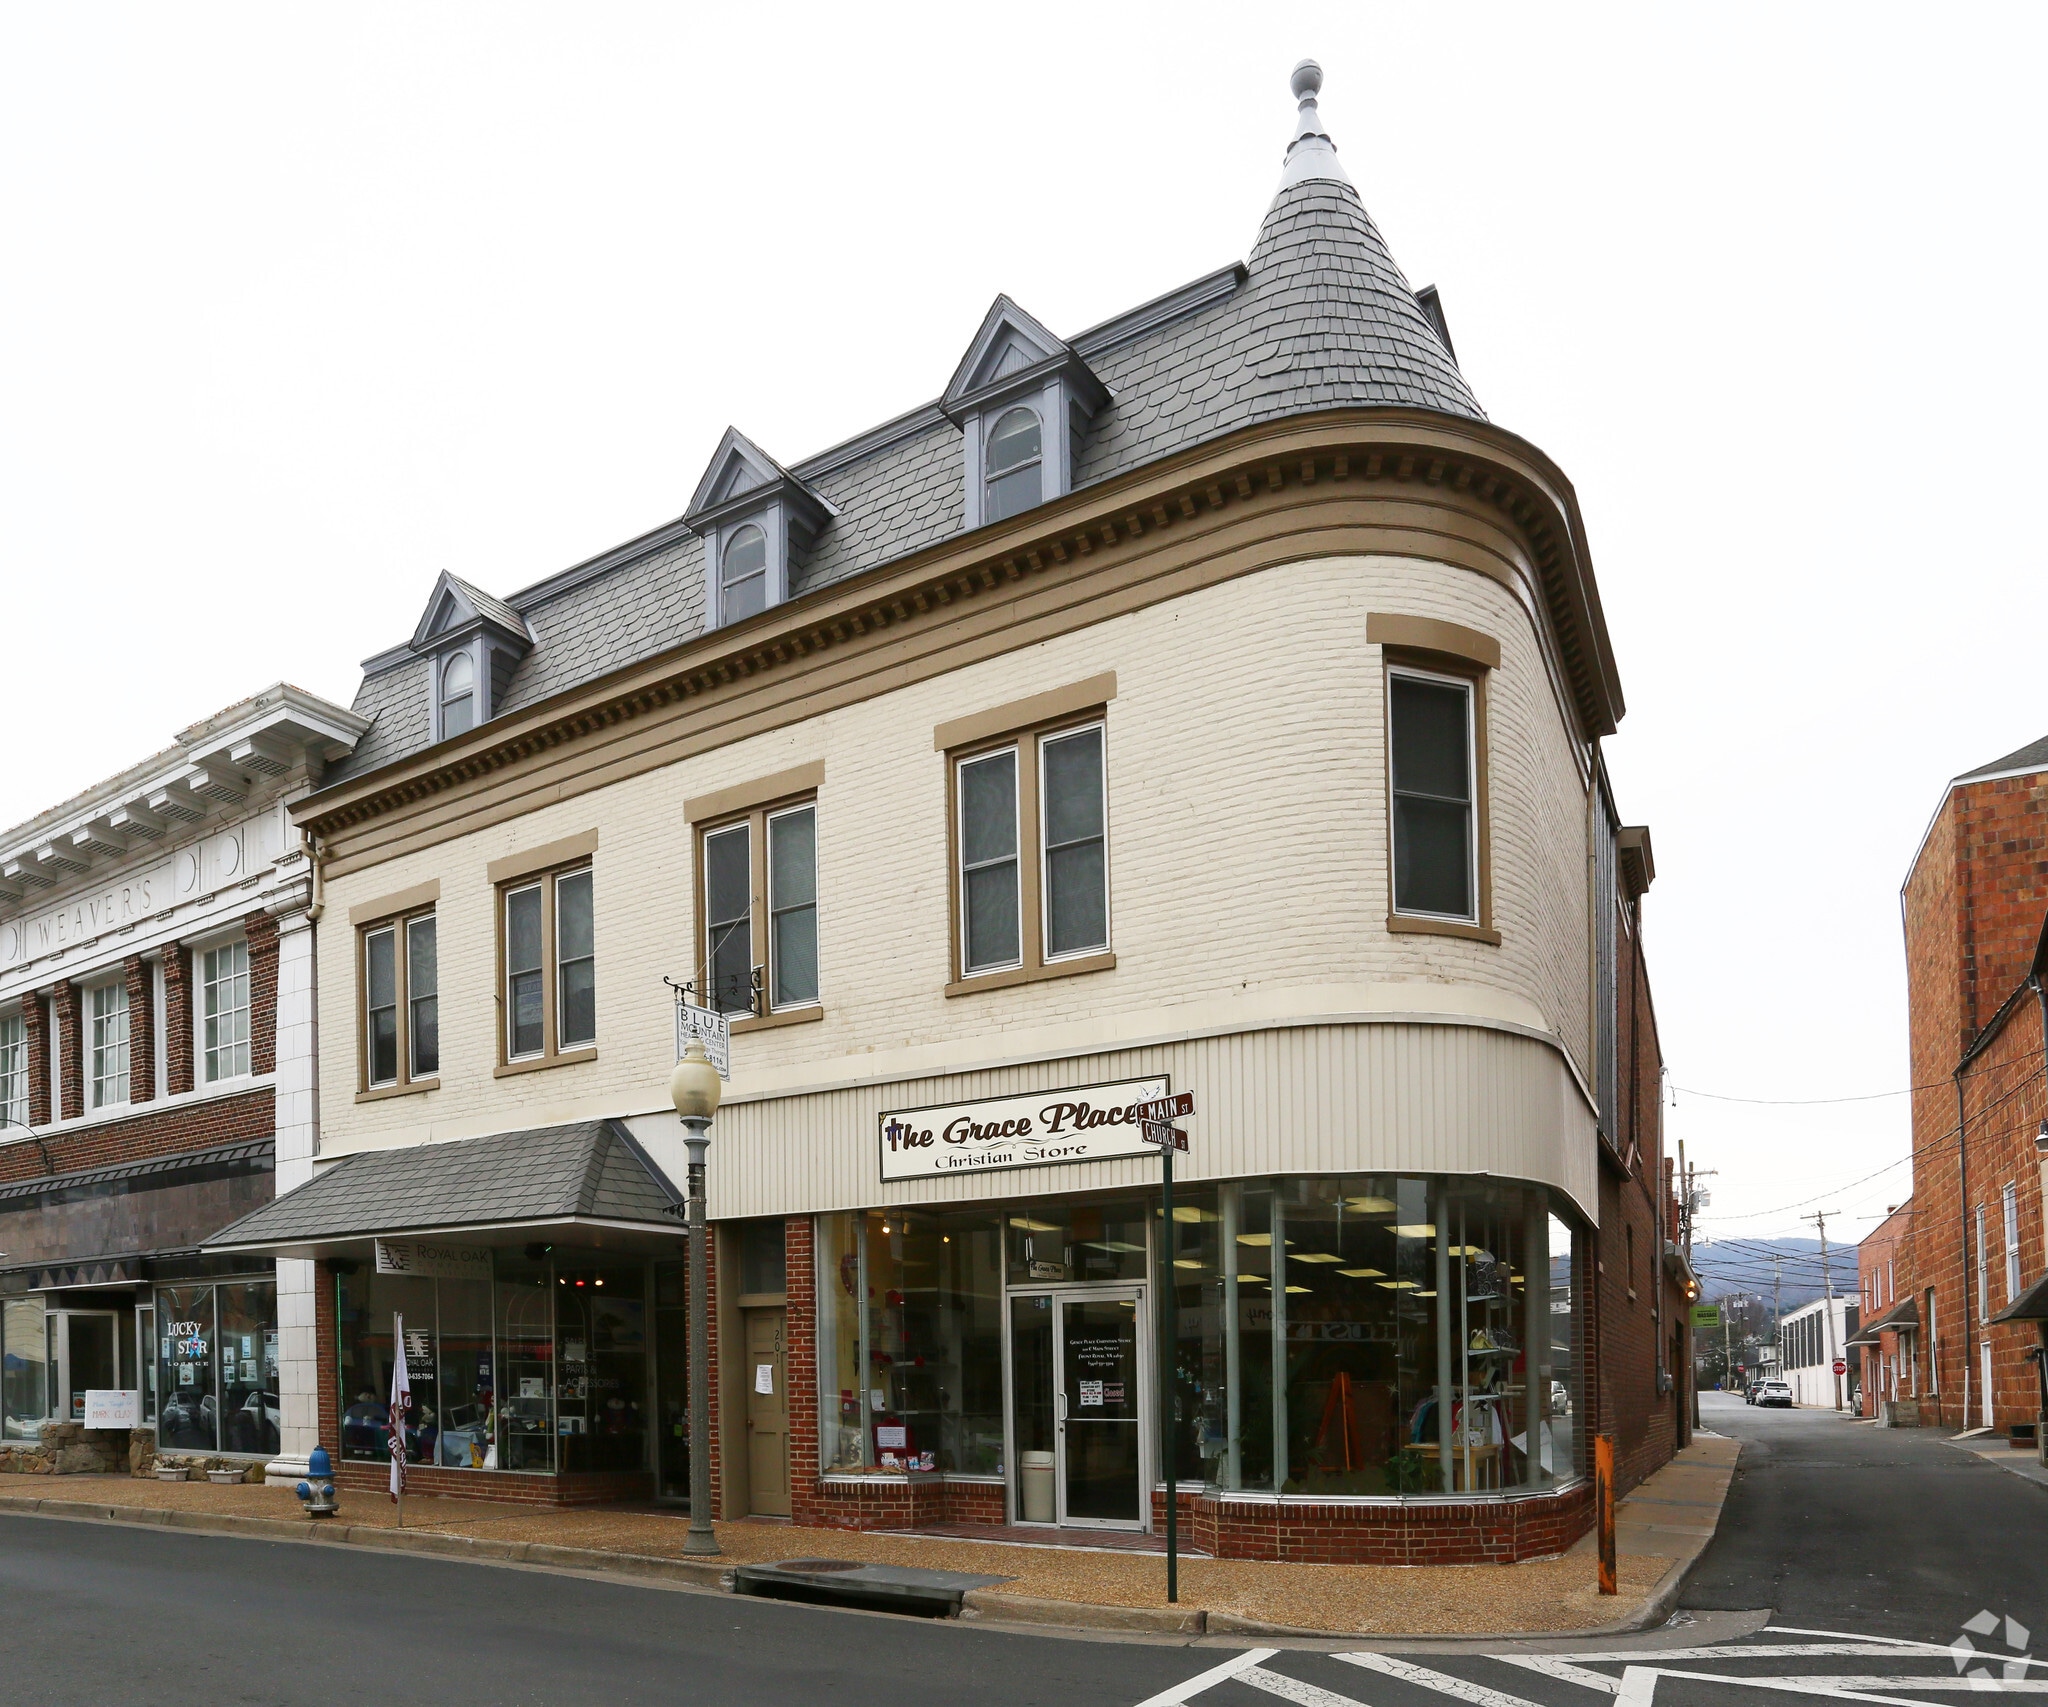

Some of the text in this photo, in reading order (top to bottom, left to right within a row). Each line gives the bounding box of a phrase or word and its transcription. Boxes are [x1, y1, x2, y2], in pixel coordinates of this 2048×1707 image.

[37, 879, 151, 949] WEAVER'S
[680, 1008, 725, 1033] BLUE
[681, 1022, 726, 1042] MOUNTAIN
[705, 1037, 726, 1049] CENTER
[1140, 1098, 1189, 1120] E MAIN ST
[942, 1116, 1033, 1145] Grace
[1039, 1102, 1137, 1134] Place
[1145, 1123, 1177, 1147] CHURCH
[935, 1145, 1088, 1169] Christian Store
[417, 1244, 489, 1264] ROYAL OAK
[167, 1321, 202, 1337] LUCKY
[565, 1337, 585, 1345] SALES
[407, 1357, 434, 1367] OYAL OAK
[565, 1364, 588, 1375] PARTS
[566, 1378, 620, 1389] ACSSORIES
